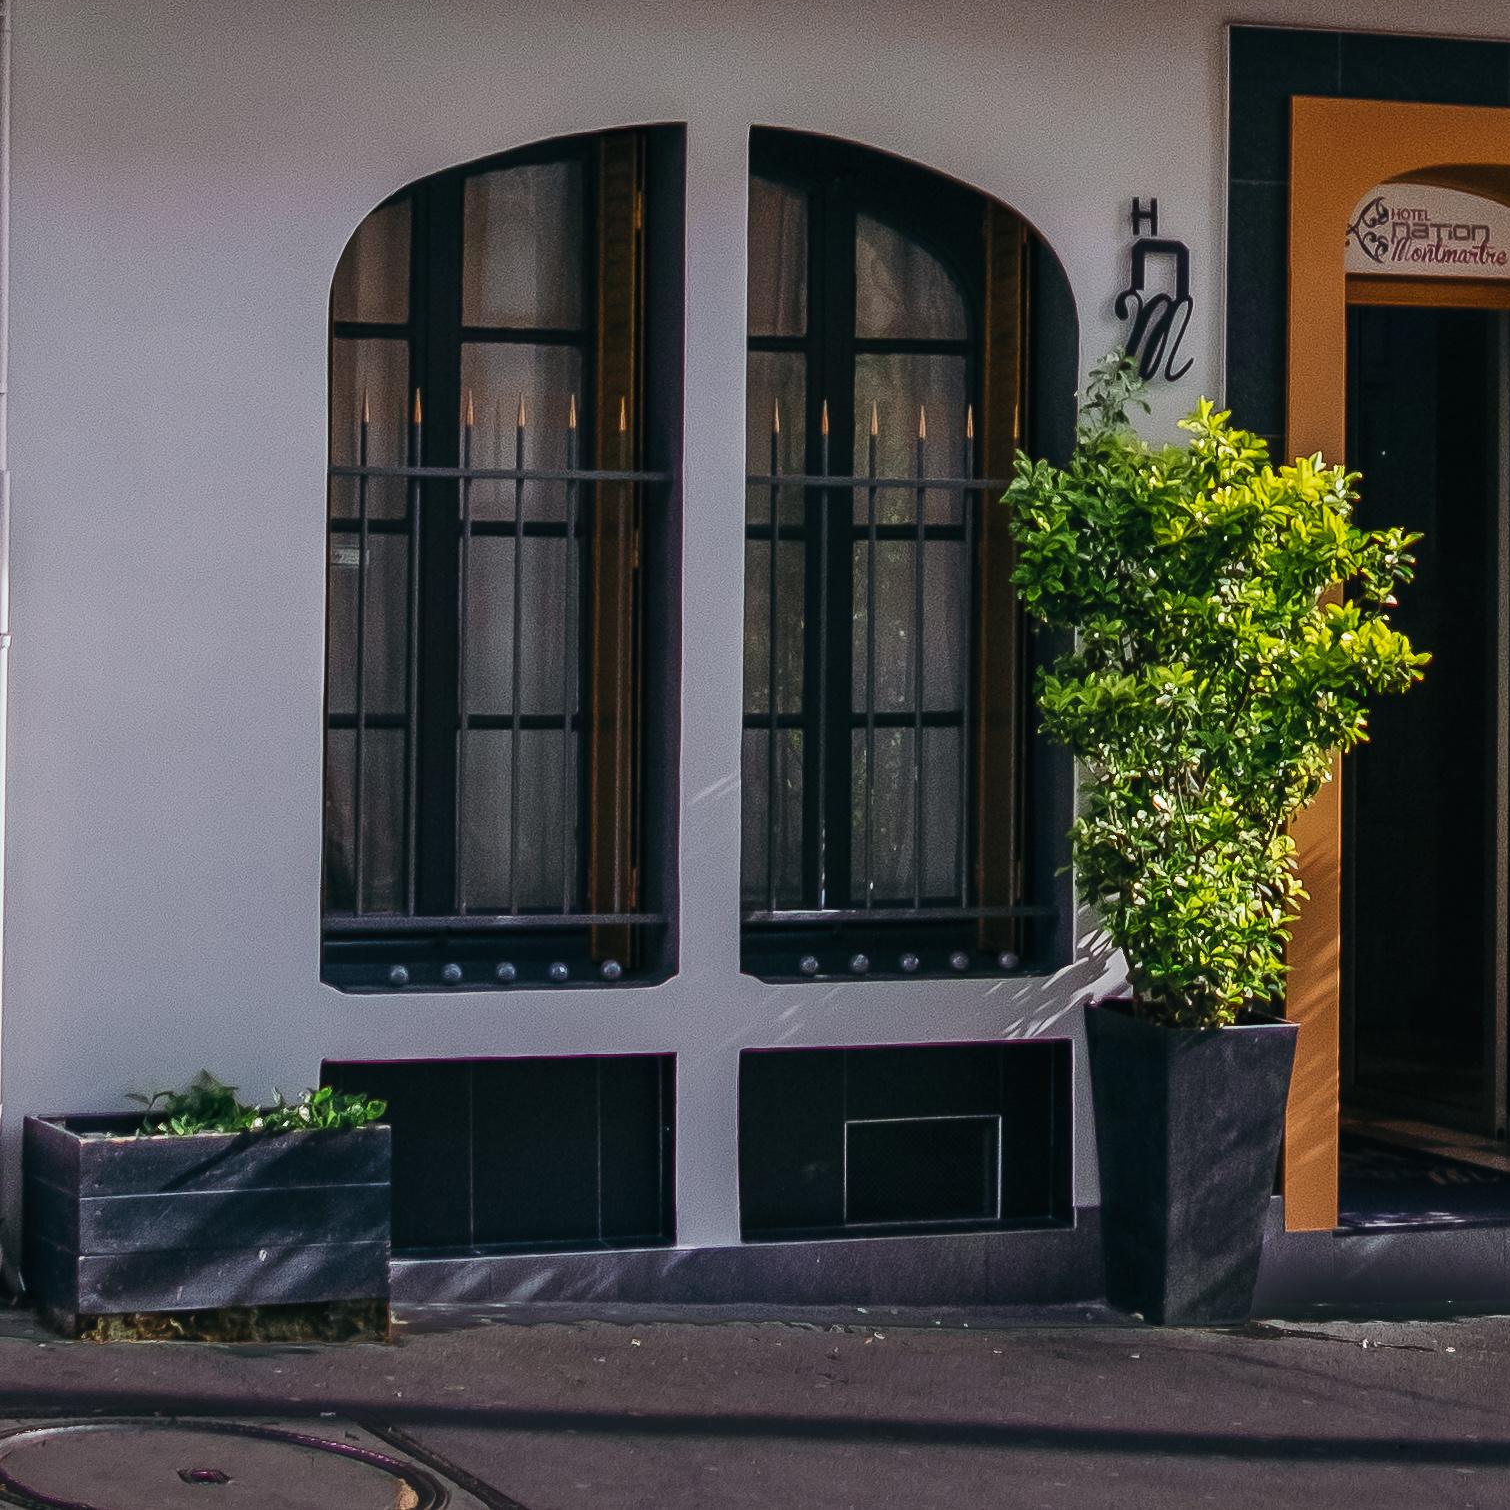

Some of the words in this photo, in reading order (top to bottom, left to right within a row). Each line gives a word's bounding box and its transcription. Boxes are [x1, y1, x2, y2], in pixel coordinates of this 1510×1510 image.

[1131, 197, 1158, 236] H
[1391, 208, 1430, 221] HOTEL
[1390, 237, 1508, 265] Montmartre
